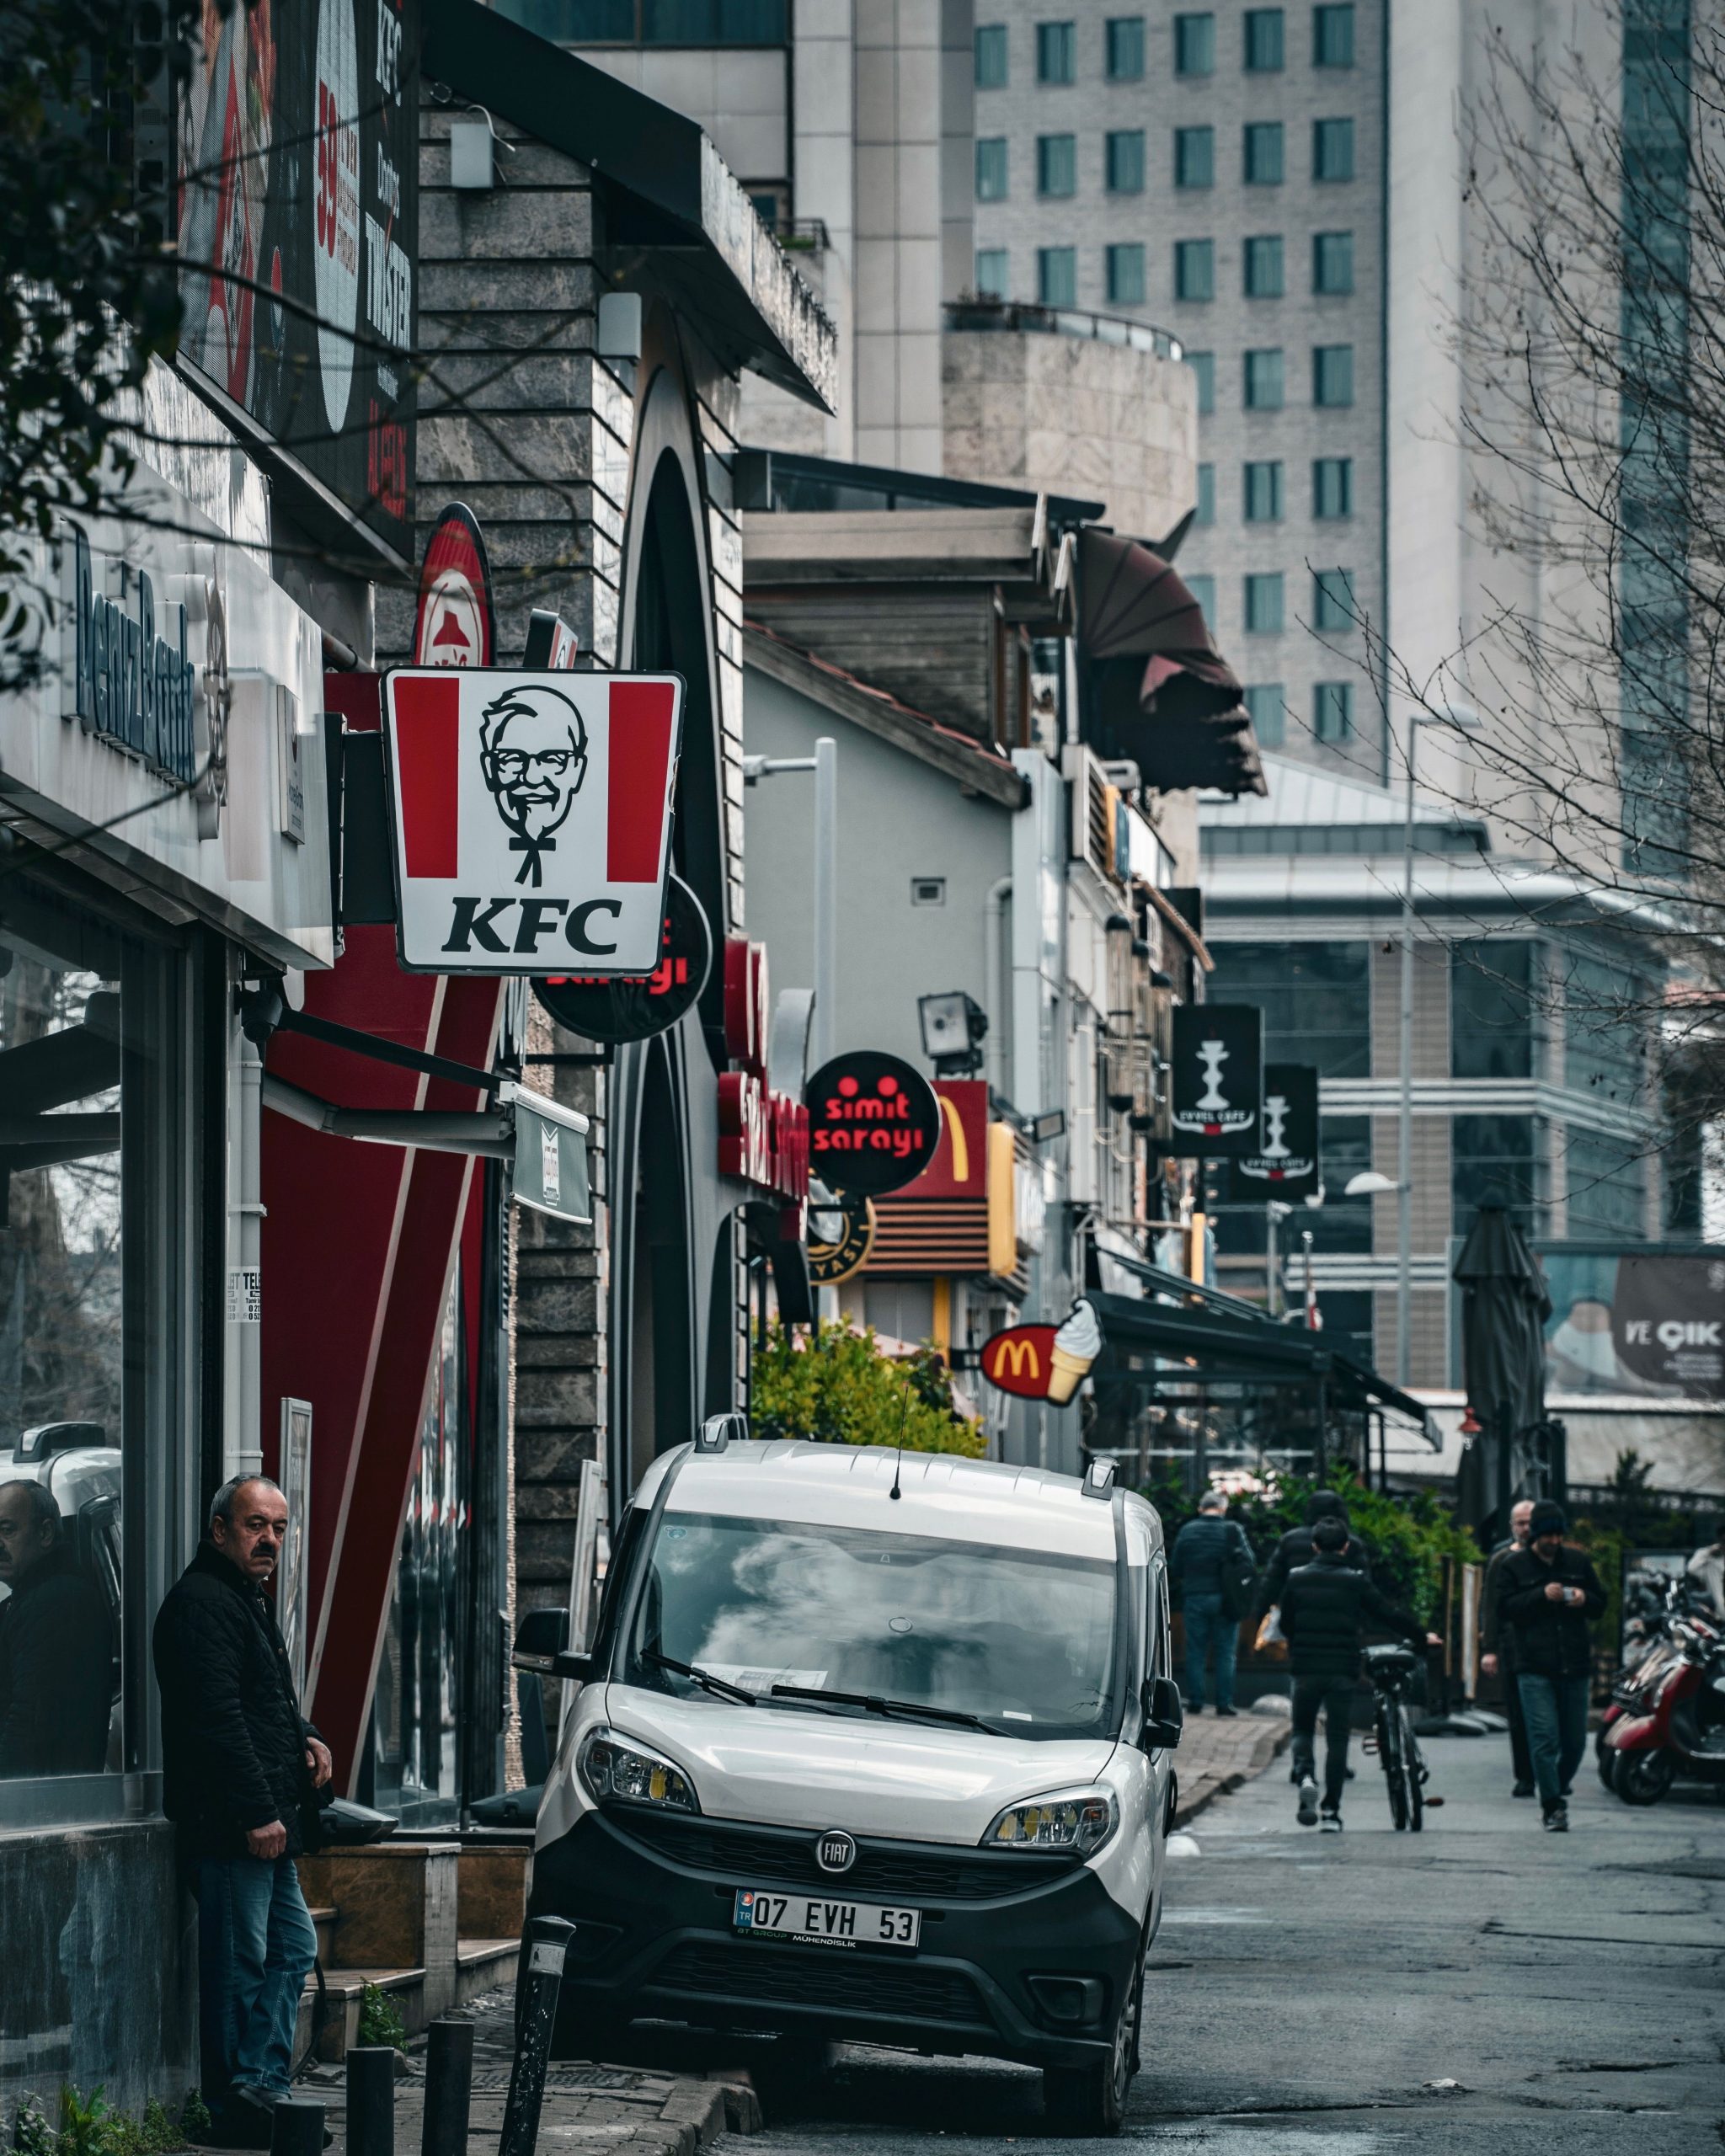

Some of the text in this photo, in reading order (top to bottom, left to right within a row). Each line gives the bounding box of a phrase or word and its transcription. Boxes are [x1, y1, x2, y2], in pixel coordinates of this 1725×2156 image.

[376, 1, 402, 107] KFC
[318, 77, 337, 258] 59
[366, 211, 411, 362] TWISTER
[75, 519, 196, 787] DenizBank
[441, 896, 622, 955] KFC
[825, 1076, 911, 1120] simit
[825, 1842, 849, 1863] FIAT
[739, 1911, 751, 1921] TR
[754, 1897, 913, 1941] 07 EVH 53
[792, 1935, 857, 1948] MÜHENDİSLİK
